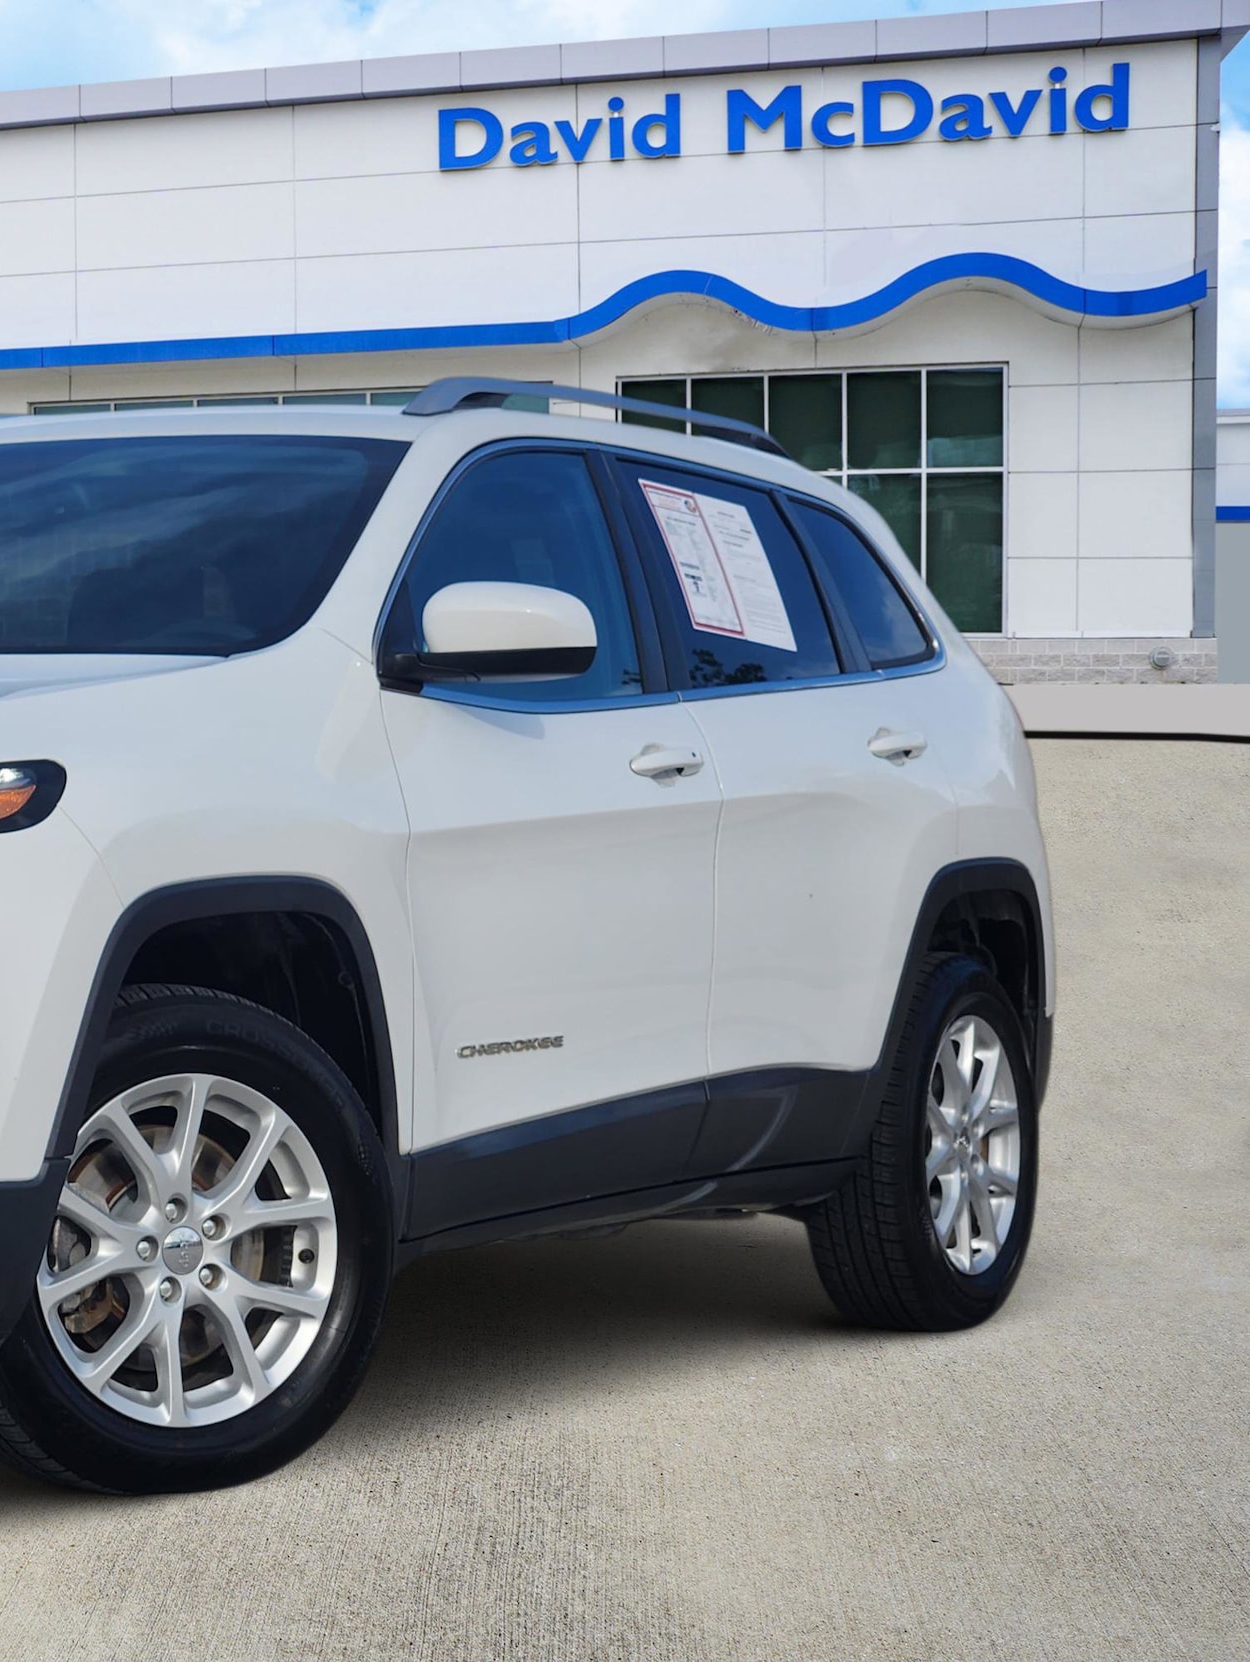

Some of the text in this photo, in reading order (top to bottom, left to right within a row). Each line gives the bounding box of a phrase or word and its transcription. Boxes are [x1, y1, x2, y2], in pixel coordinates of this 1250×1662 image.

[438, 62, 1130, 172] David McDavid
[458, 1035, 564, 1058] CHEROKEE
